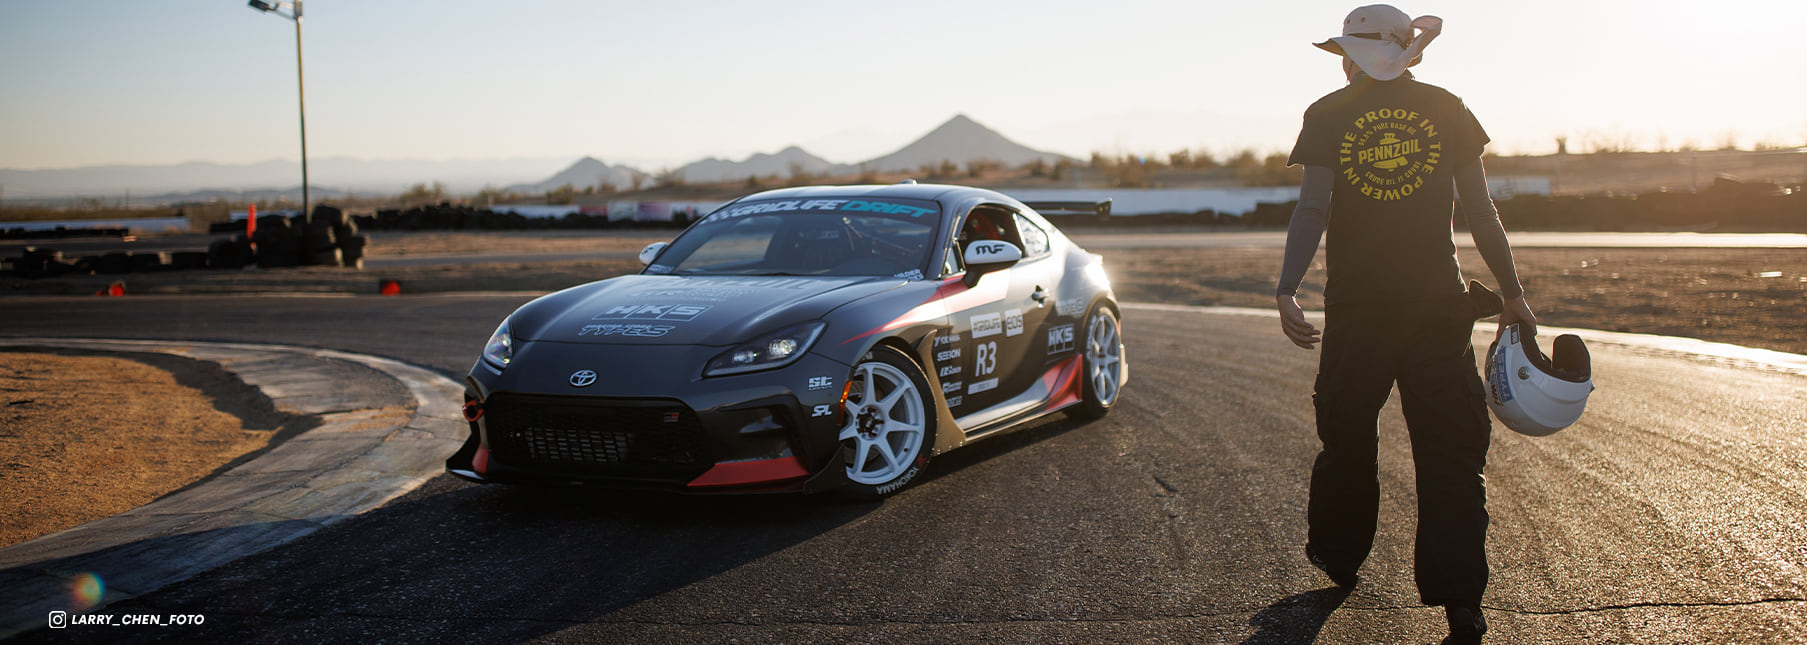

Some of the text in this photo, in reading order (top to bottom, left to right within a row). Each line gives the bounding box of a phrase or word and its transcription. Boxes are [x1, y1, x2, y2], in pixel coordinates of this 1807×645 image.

[1340, 108, 1440, 201] PROOF IN THE POWER IN THE
[1358, 138, 1421, 165] PENNZOIL
[840, 201, 937, 218] DRIFT
[604, 304, 708, 316] HKS
[1048, 326, 1073, 346] HKS
[975, 341, 997, 377] R3
[876, 466, 919, 495] YOKOHAMA
